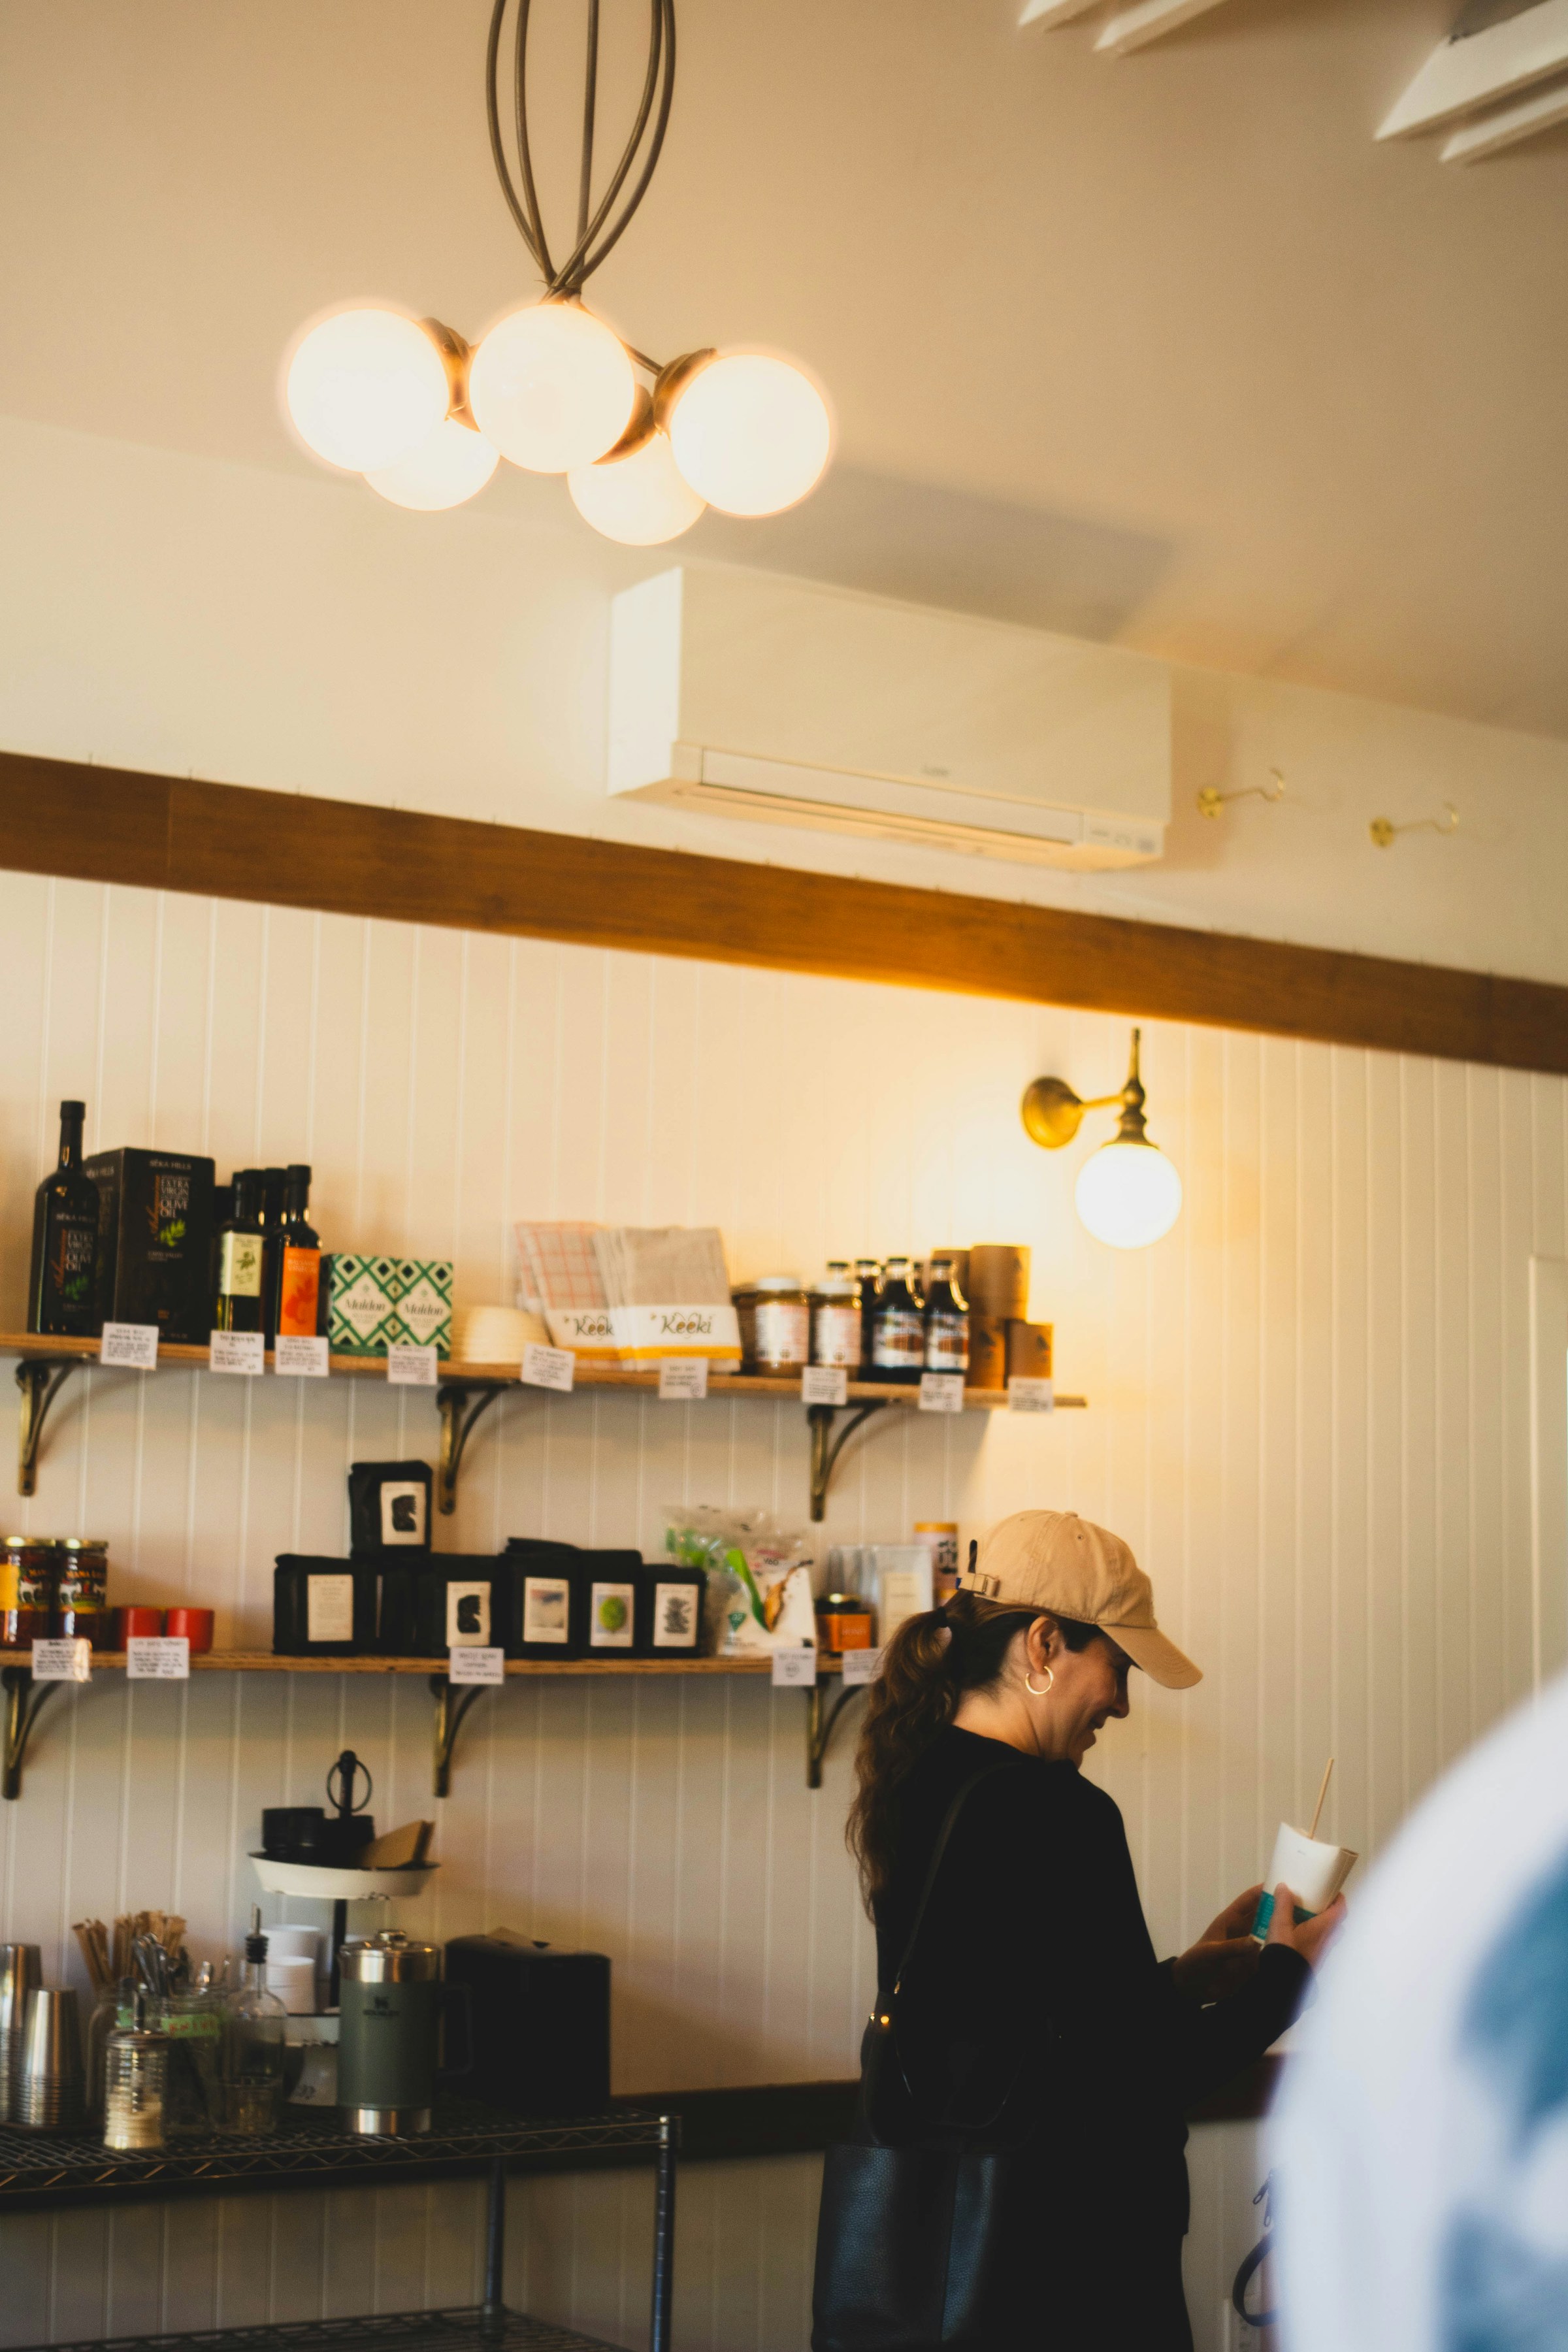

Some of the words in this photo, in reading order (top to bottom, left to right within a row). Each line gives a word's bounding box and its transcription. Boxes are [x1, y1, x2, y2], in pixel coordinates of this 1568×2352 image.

[161, 1179, 189, 1188] EXTRA
[161, 1187, 188, 1196] VIRGIN
[161, 1200, 188, 1210] OLIVE
[161, 1209, 177, 1218] OIL
[346, 1299, 386, 1312] Maldon
[404, 1303, 444, 1316] Maldon
[574, 1315, 615, 1337] Keek
[661, 1312, 712, 1339] Keeki
